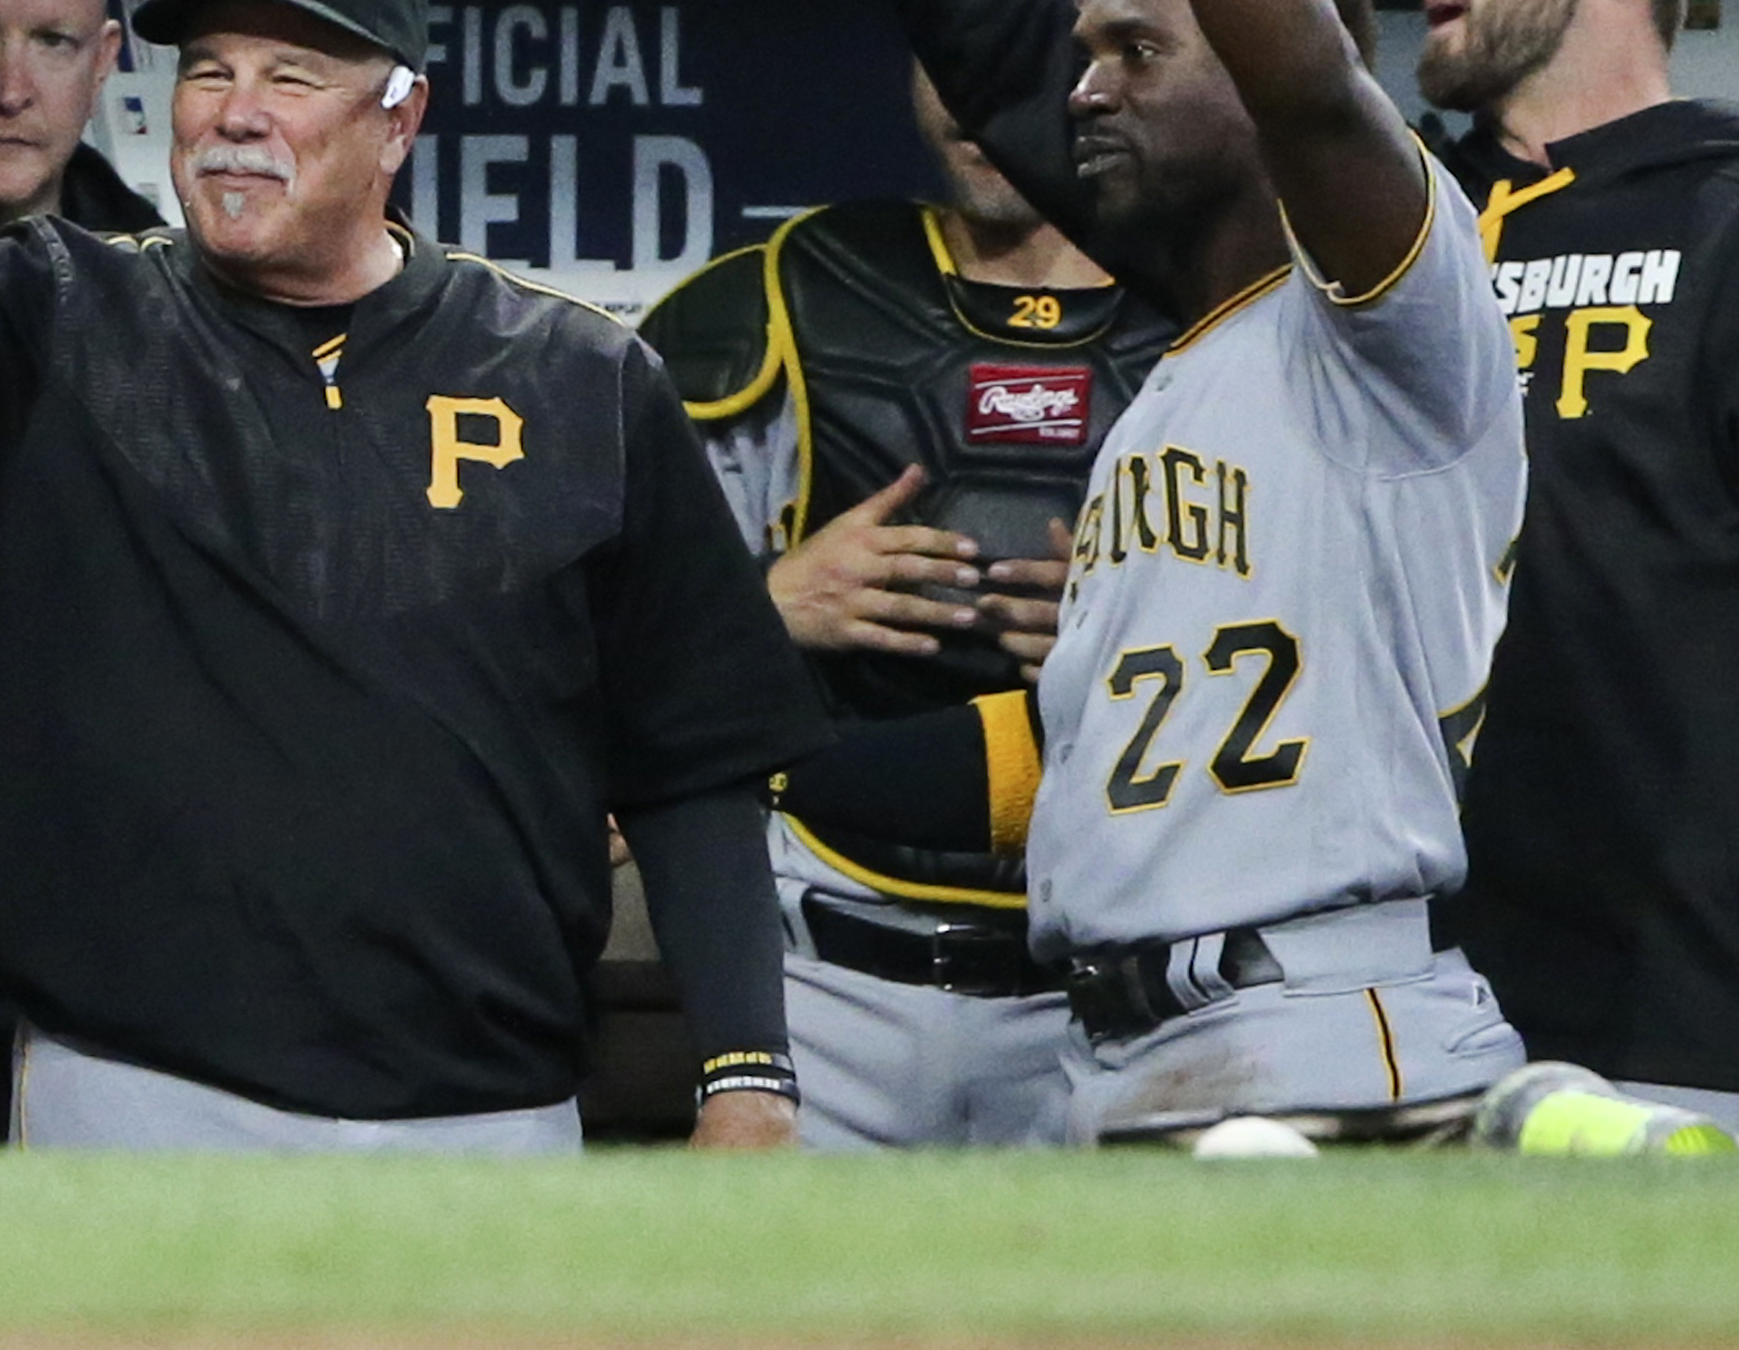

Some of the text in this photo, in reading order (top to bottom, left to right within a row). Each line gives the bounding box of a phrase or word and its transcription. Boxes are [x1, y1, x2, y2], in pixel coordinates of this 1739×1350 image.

[1007, 295, 1063, 329] 29
[1491, 250, 1681, 314] SBURGH
[1555, 305, 1653, 419] P
[425, 395, 524, 508] P
[1105, 618, 1309, 815] 22
